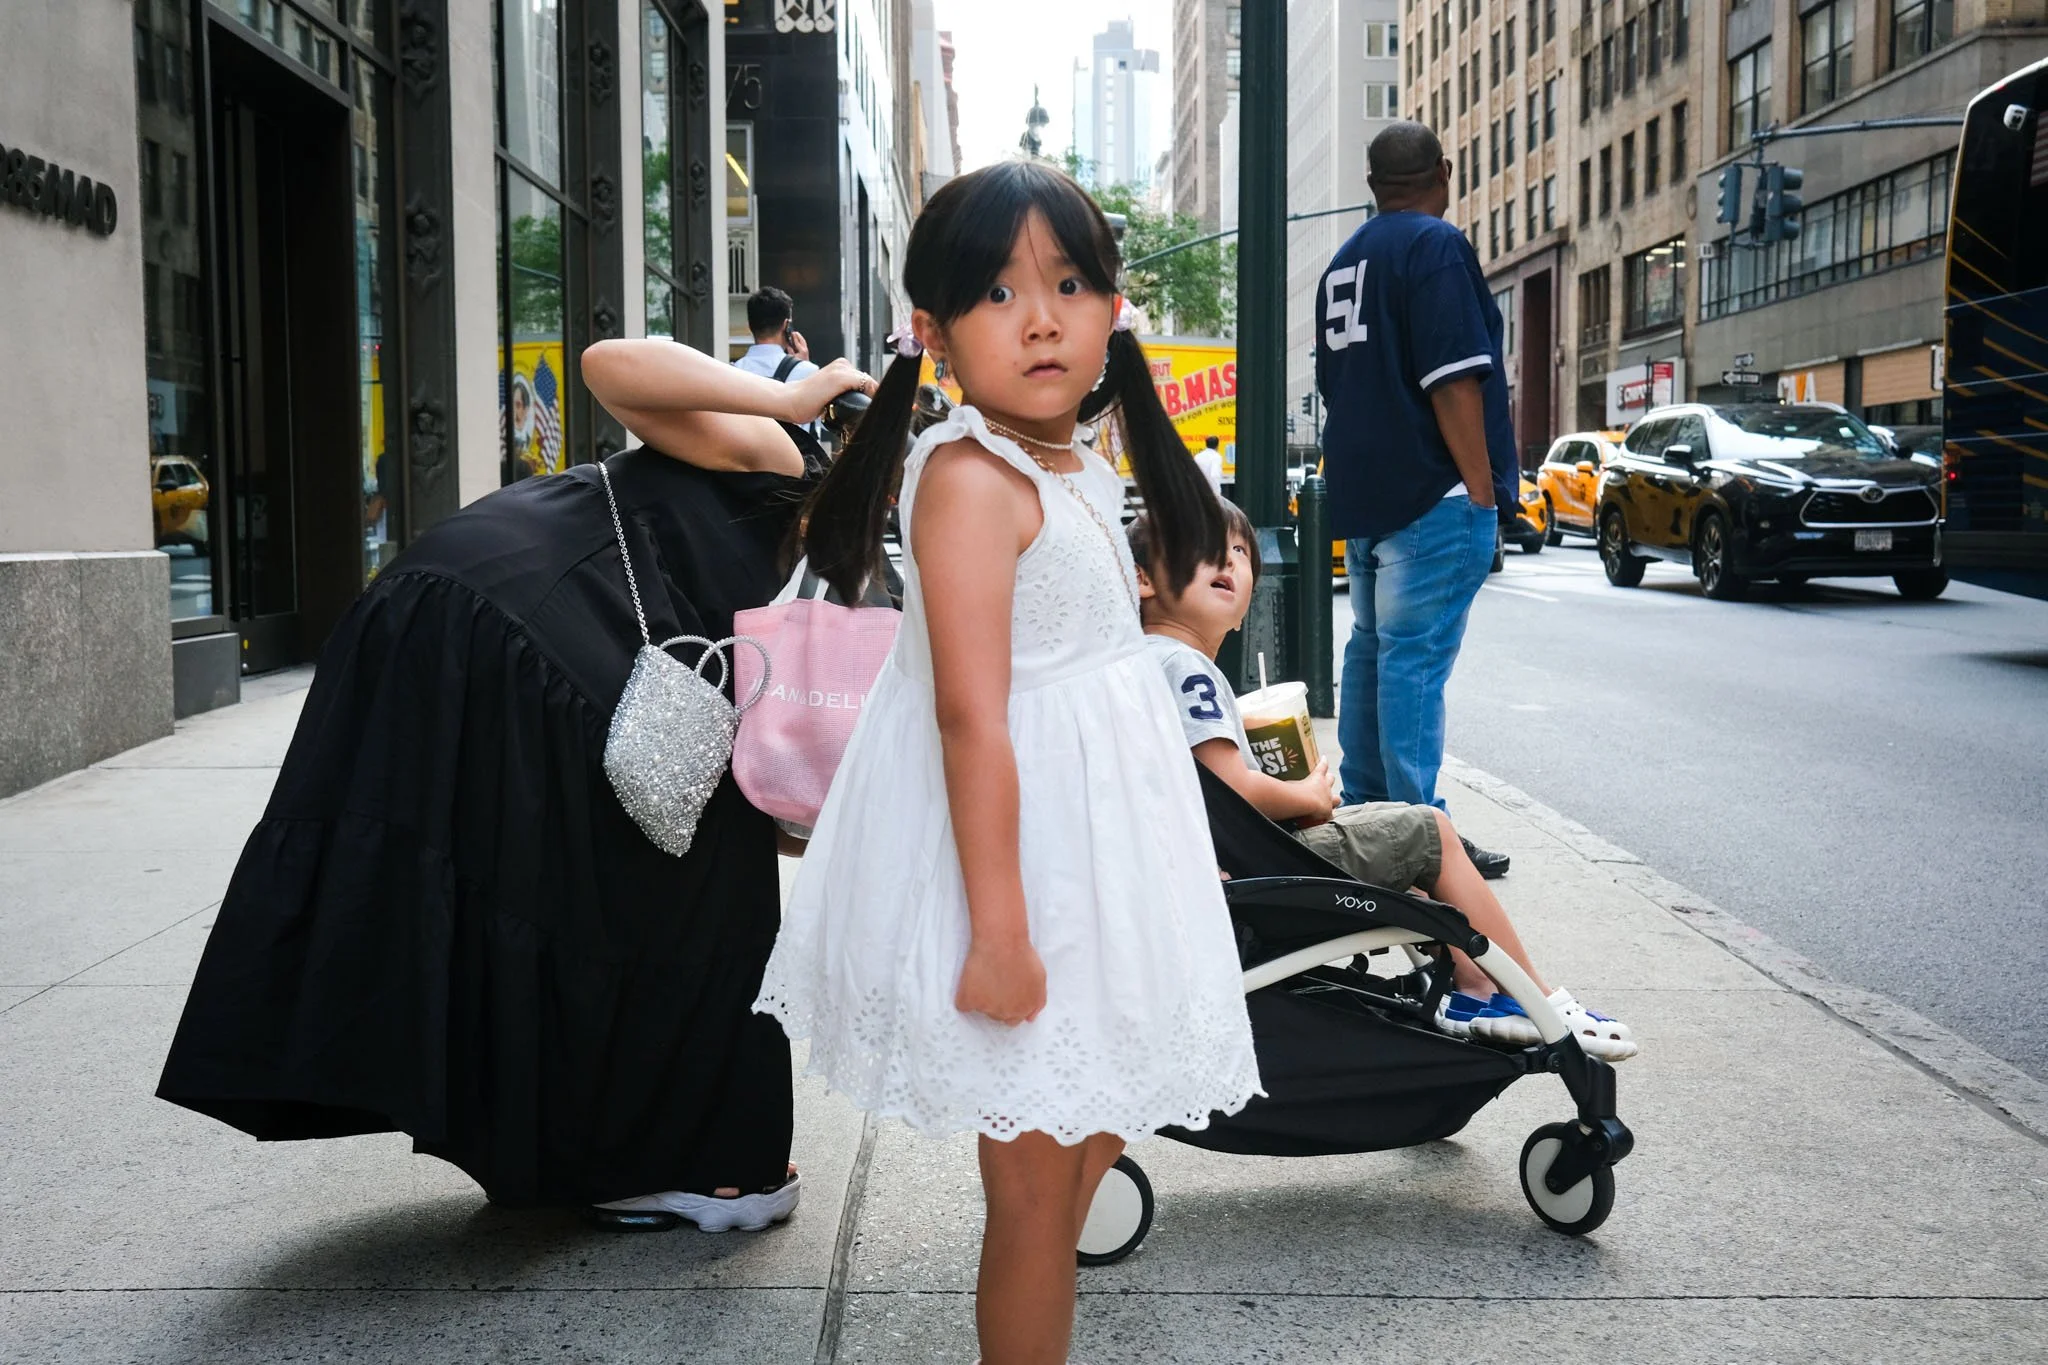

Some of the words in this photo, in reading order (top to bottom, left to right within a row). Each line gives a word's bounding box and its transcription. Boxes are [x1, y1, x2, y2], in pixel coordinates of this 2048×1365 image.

[1325, 259, 1368, 351] 51
[1181, 673, 1223, 720] 3
[1250, 737, 1281, 753] THE
[1335, 894, 1376, 912] YOYO
